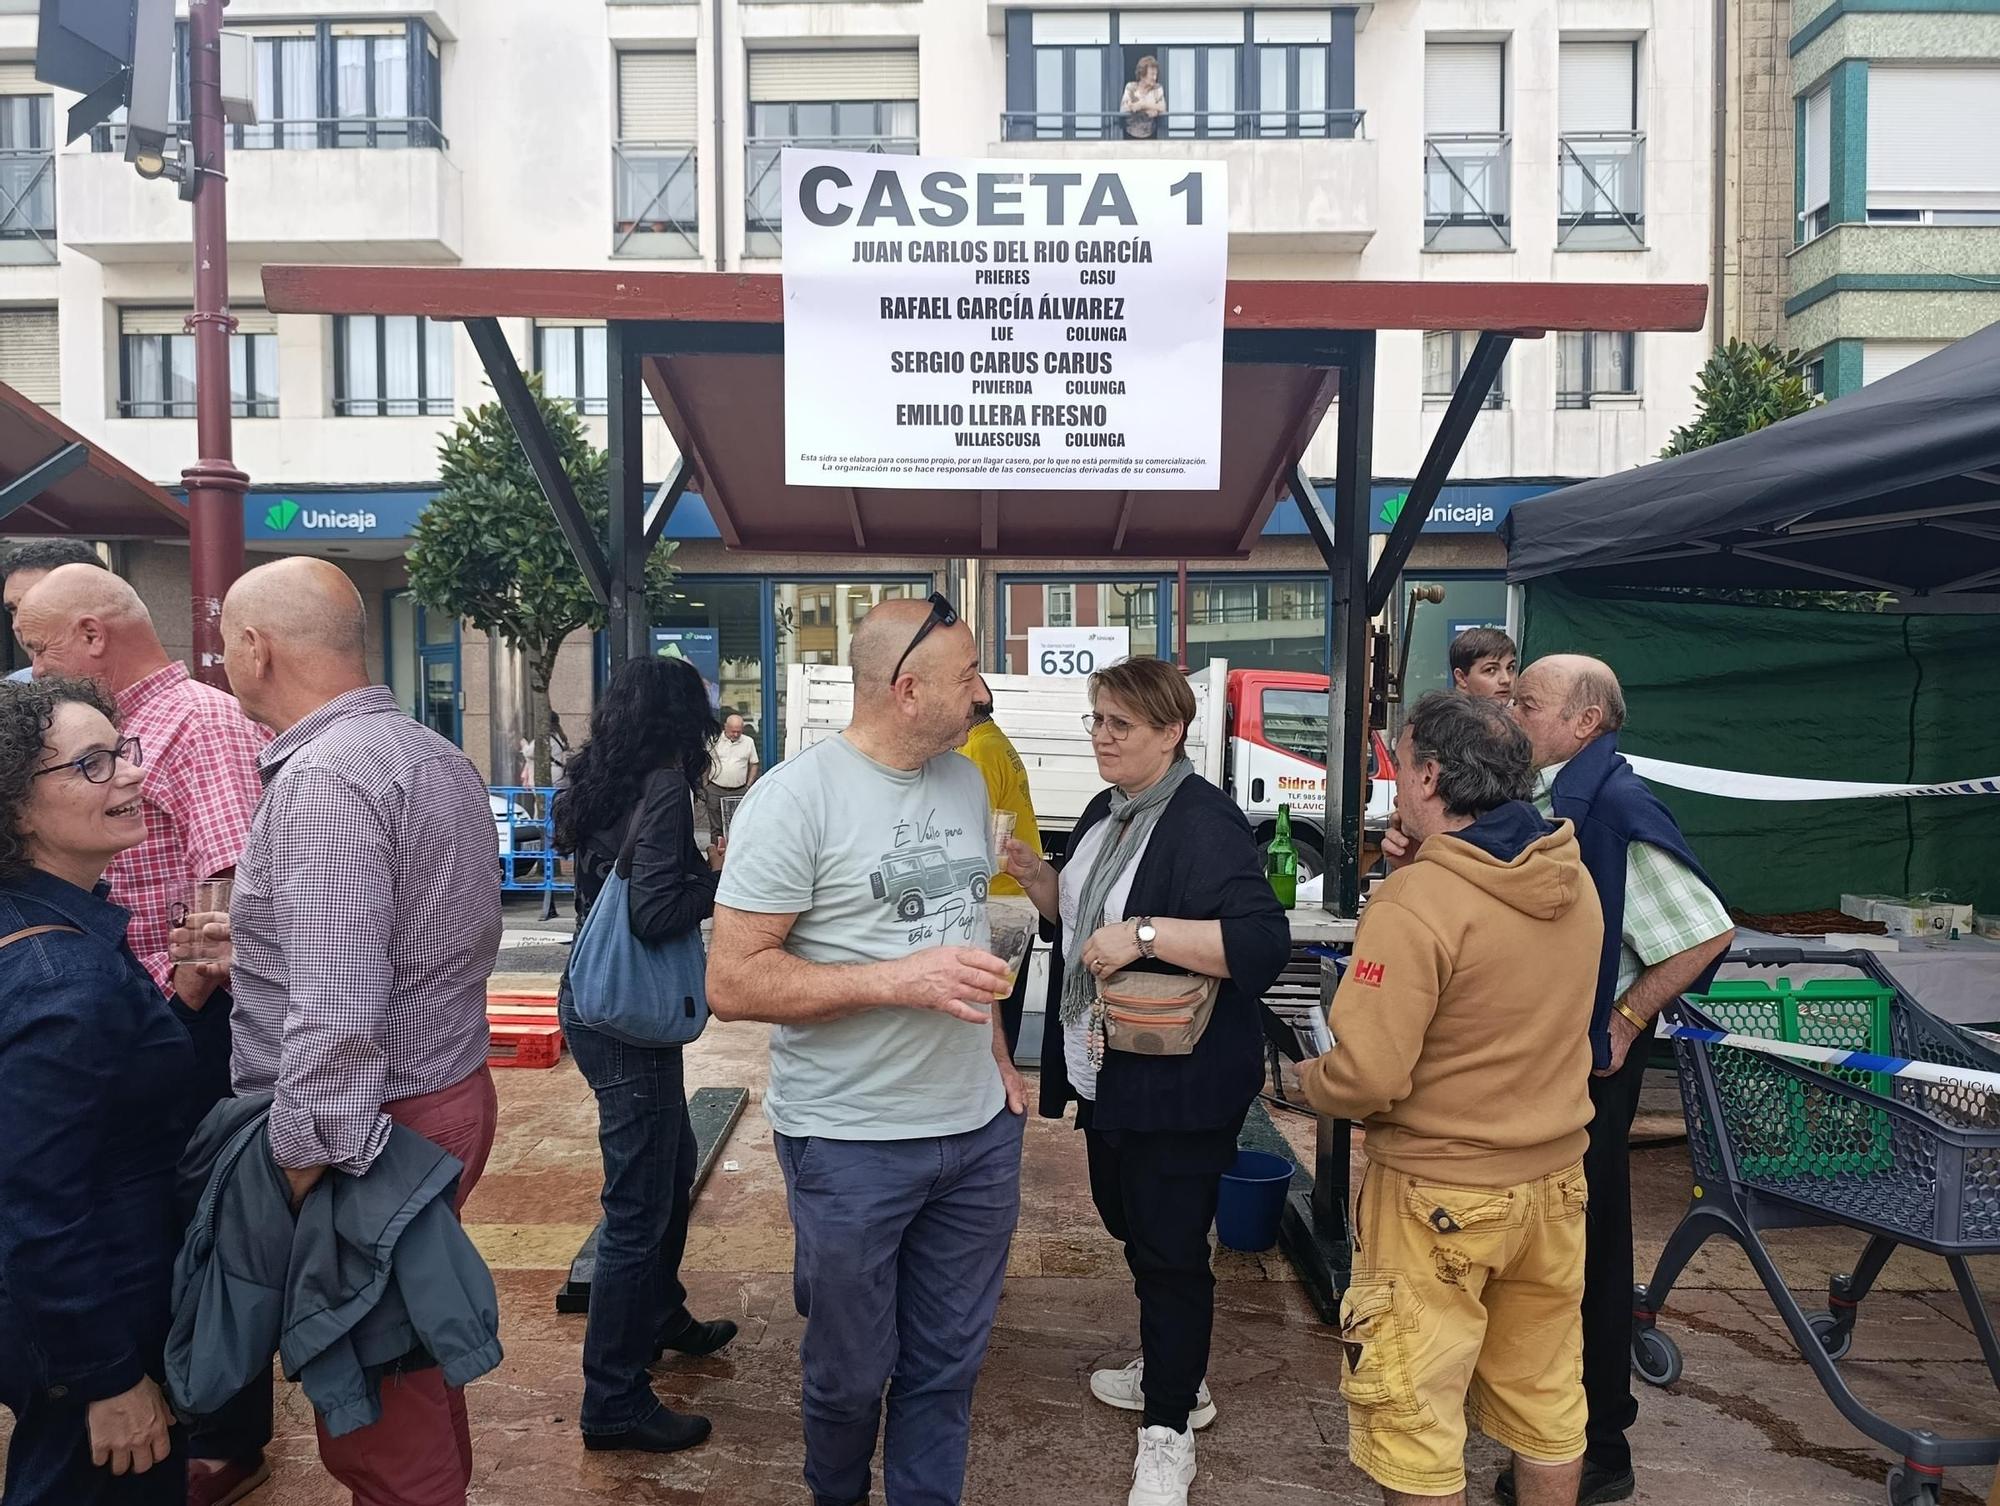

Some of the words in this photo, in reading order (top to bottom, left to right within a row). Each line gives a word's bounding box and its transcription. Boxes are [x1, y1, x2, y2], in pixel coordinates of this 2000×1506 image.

[799, 166, 1138, 227] CASETA
[1169, 172, 1203, 226] 1
[852, 240, 903, 263] JUAN
[908, 240, 989, 264] CARLOS
[993, 240, 1029, 263] DEL
[1033, 240, 1070, 263] RIO
[1074, 236, 1153, 264] GARCÍA
[975, 269, 1031, 286] PRIERES
[1079, 269, 1116, 286] CASU
[880, 296, 953, 320] RAFAEL
[956, 292, 1034, 321] GARCÍA
[1037, 292, 1125, 321] ÁLVAREZ
[991, 326, 1014, 342] LUE
[1066, 326, 1128, 342] COLUNGA
[890, 350, 965, 374] SERGIO
[969, 350, 1039, 375] CARUS
[1043, 351, 1113, 375] CARUS
[972, 380, 1033, 395] PIVIERDA
[1065, 380, 1127, 396] COLUNGA
[896, 403, 964, 427] EMILIO
[968, 404, 1027, 427] LLERA
[1031, 404, 1107, 427] FRESNO
[954, 431, 1041, 448] VILLAESCUSA
[1065, 432, 1126, 448] COLUNGA
[800, 453, 817, 461] Esta
[818, 454, 837, 462] sidra
[849, 455, 877, 463] elabora
[877, 457, 895, 465] para
[930, 457, 956, 465] propio,
[983, 457, 1004, 465] llagar
[1032, 458, 1046, 466] por
[1047, 457, 1055, 465] lo
[1055, 458, 1070, 466] que
[1082, 457, 1098, 465] está
[1098, 456, 1133, 466] permitida
[822, 463, 833, 471] La
[834, 464, 889, 473] organización
[914, 465, 935, 473] hace
[936, 465, 988, 475] responsable
[989, 466, 1000, 474] de
[1001, 466, 1014, 474] las
[1015, 466, 1077, 474] consecuencias
[1079, 466, 1119, 474] derivadas
[1120, 466, 1132, 474] de
[302, 509, 377, 533] Unicaja
[1041, 650, 1094, 675] 630
[1278, 776, 1316, 790] Sidra
[1303, 793, 1316, 801] 985
[908, 923, 933, 946] está
[1355, 959, 1385, 983] HH
